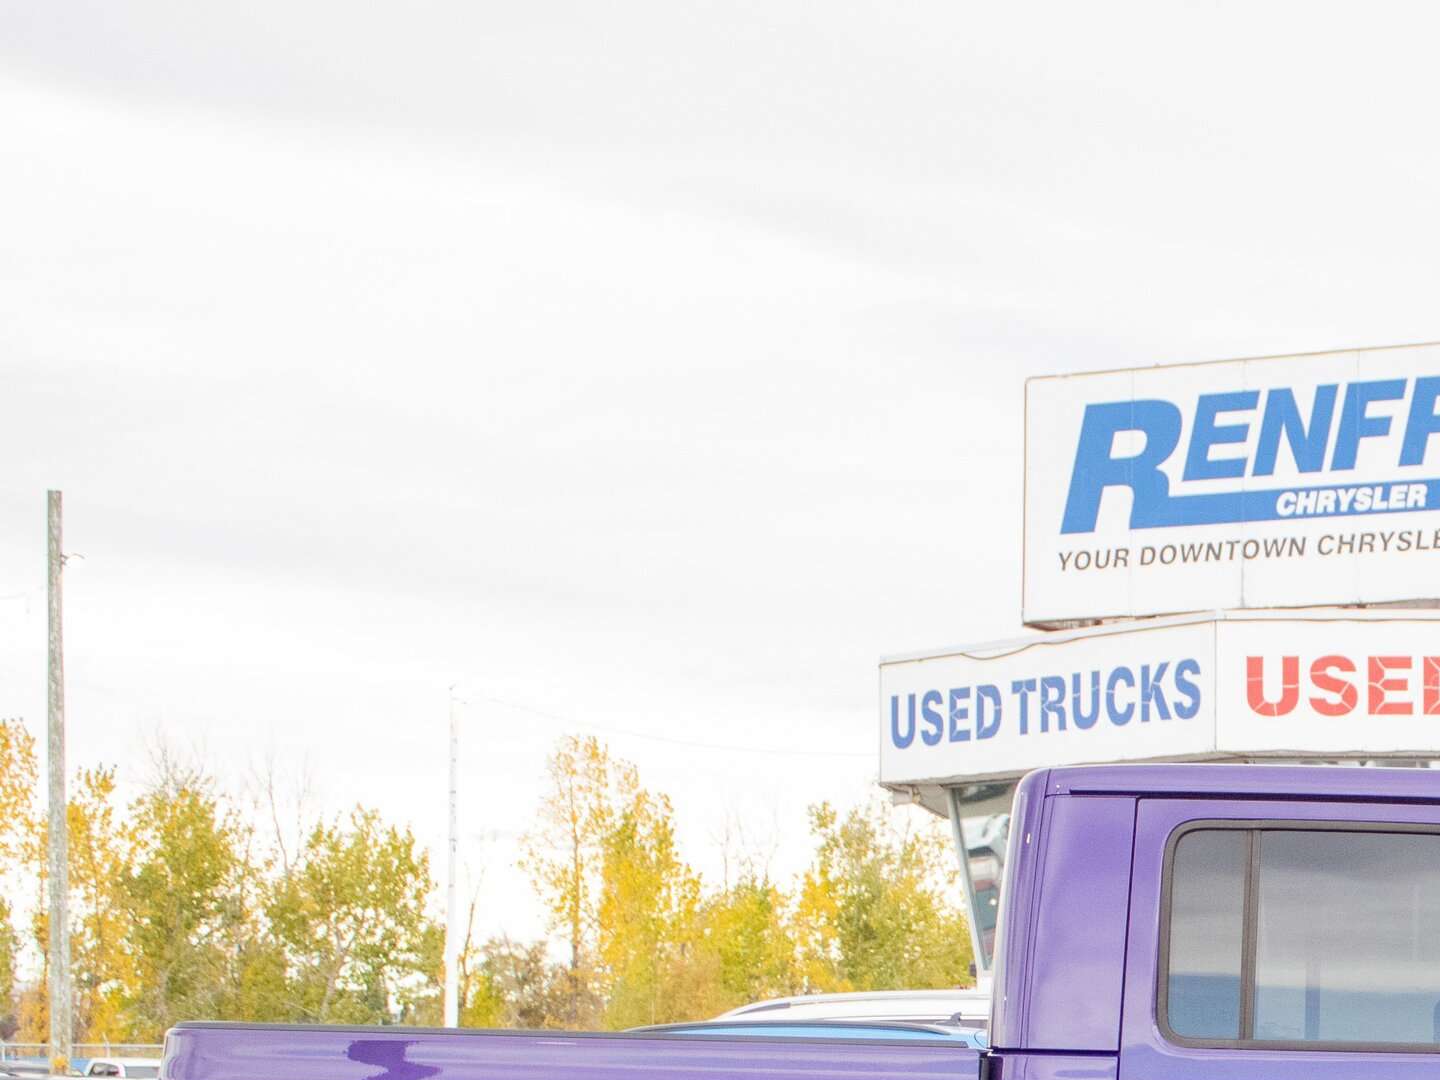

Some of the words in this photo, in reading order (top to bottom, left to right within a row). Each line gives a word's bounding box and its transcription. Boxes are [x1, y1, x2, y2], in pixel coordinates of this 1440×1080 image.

[1276, 482, 1428, 517] CHRYSLER
[1058, 548, 1129, 571] YOUR
[1140, 537, 1307, 566] DOWNTOWN
[891, 684, 1002, 749] USED
[1011, 658, 1201, 735] TRUCKS
